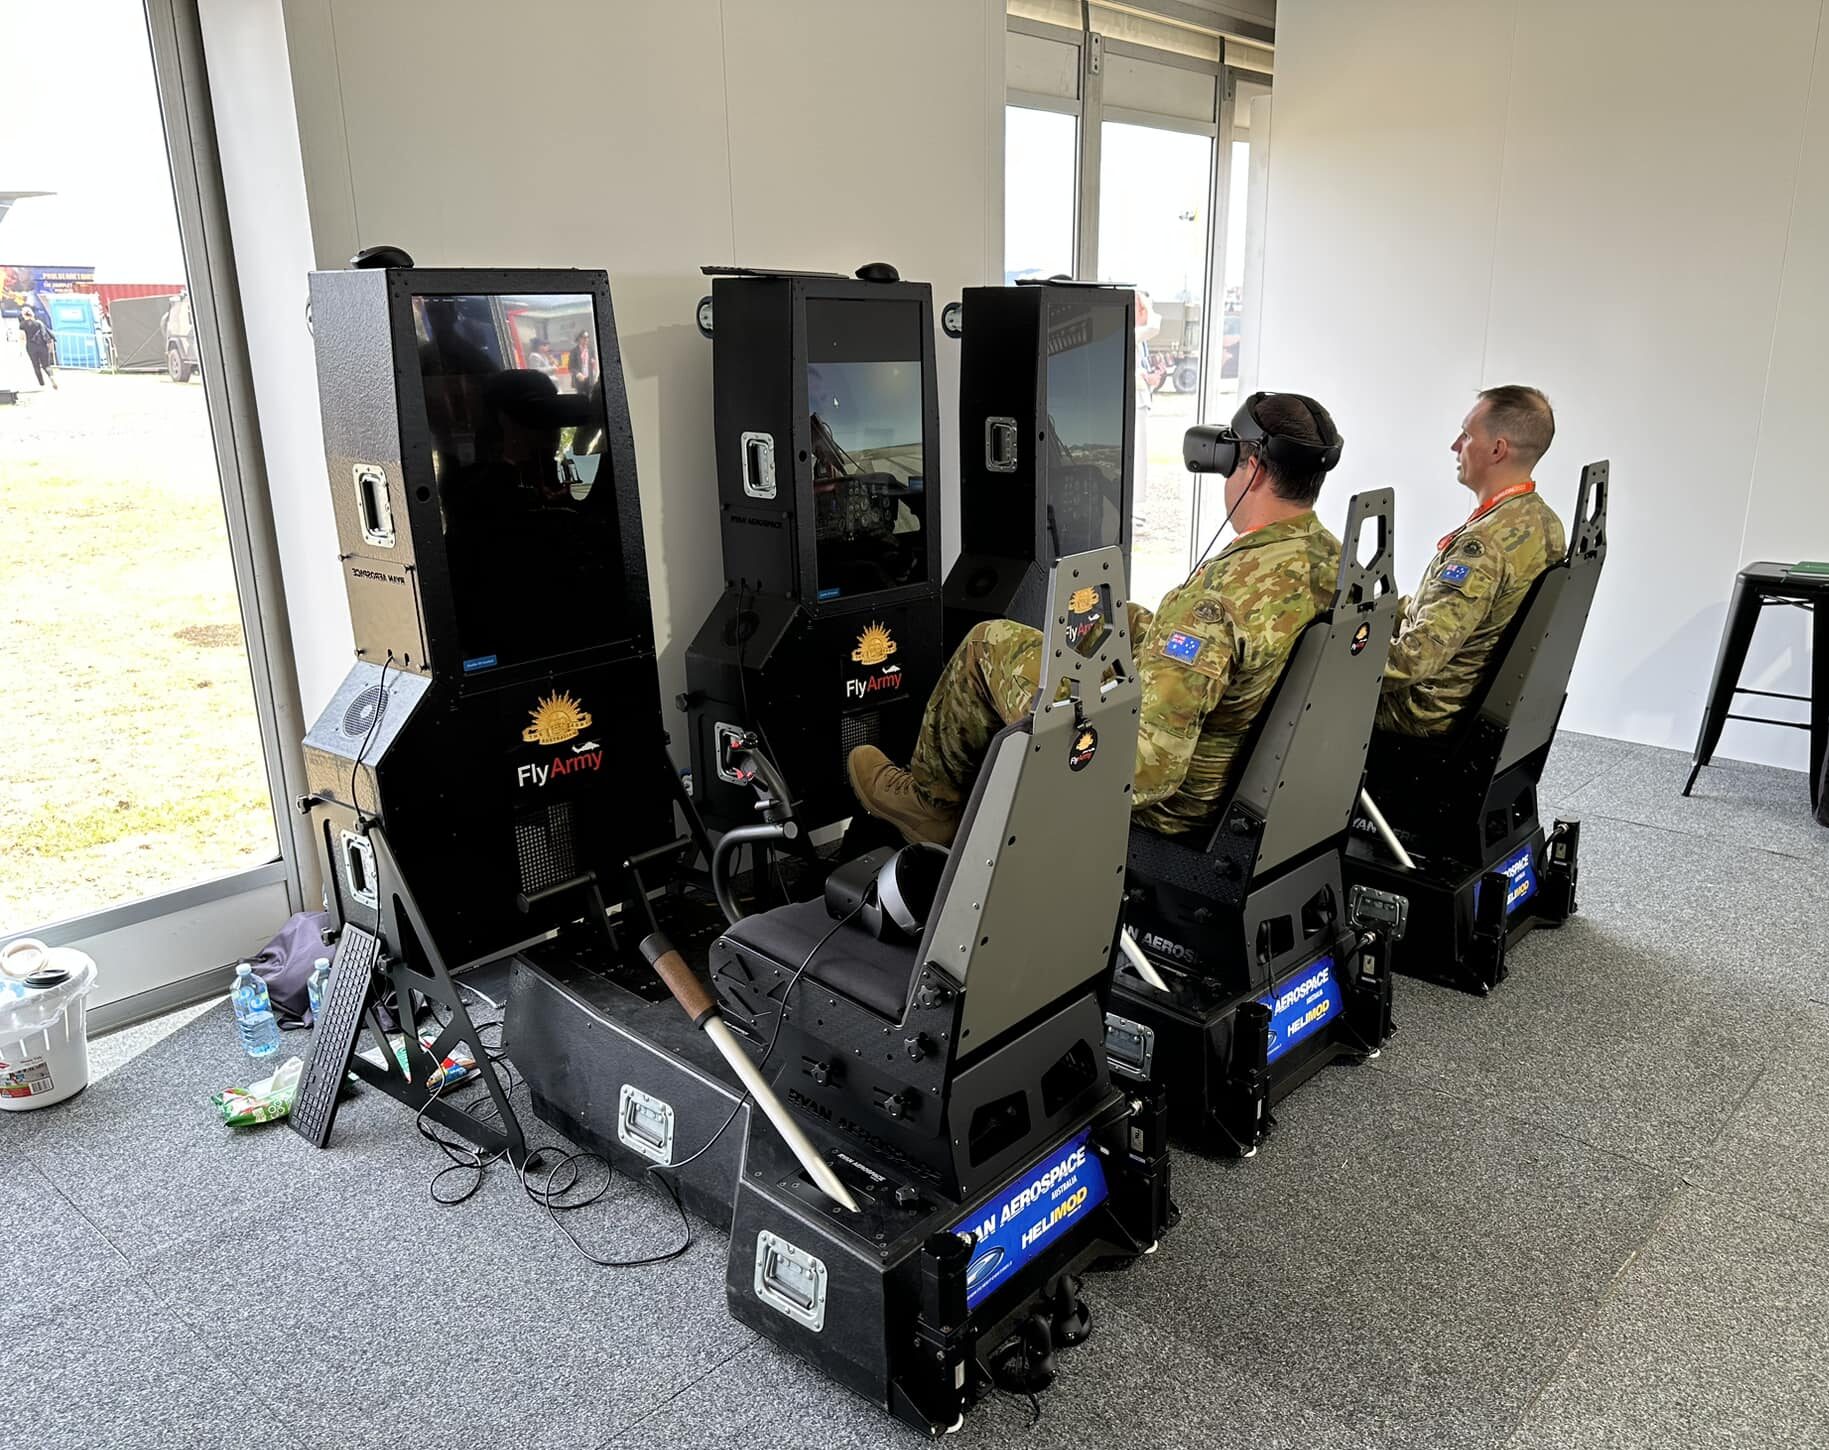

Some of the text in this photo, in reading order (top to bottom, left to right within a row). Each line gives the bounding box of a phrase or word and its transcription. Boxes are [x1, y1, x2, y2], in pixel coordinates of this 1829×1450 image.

[846, 672, 903, 698] FlyArmy
[517, 750, 603, 787] FlyArmy
[1352, 817, 1377, 834] YAN
[1141, 932, 1197, 963] AEROS
[1274, 967, 1329, 1016] AEROSPACE
[1287, 999, 1330, 1037] HELIMOD
[1000, 1145, 1087, 1228] AEROSPACE
[1051, 1174, 1078, 1200] AUSTRALIA
[1021, 1186, 1088, 1250] HELIMOD
